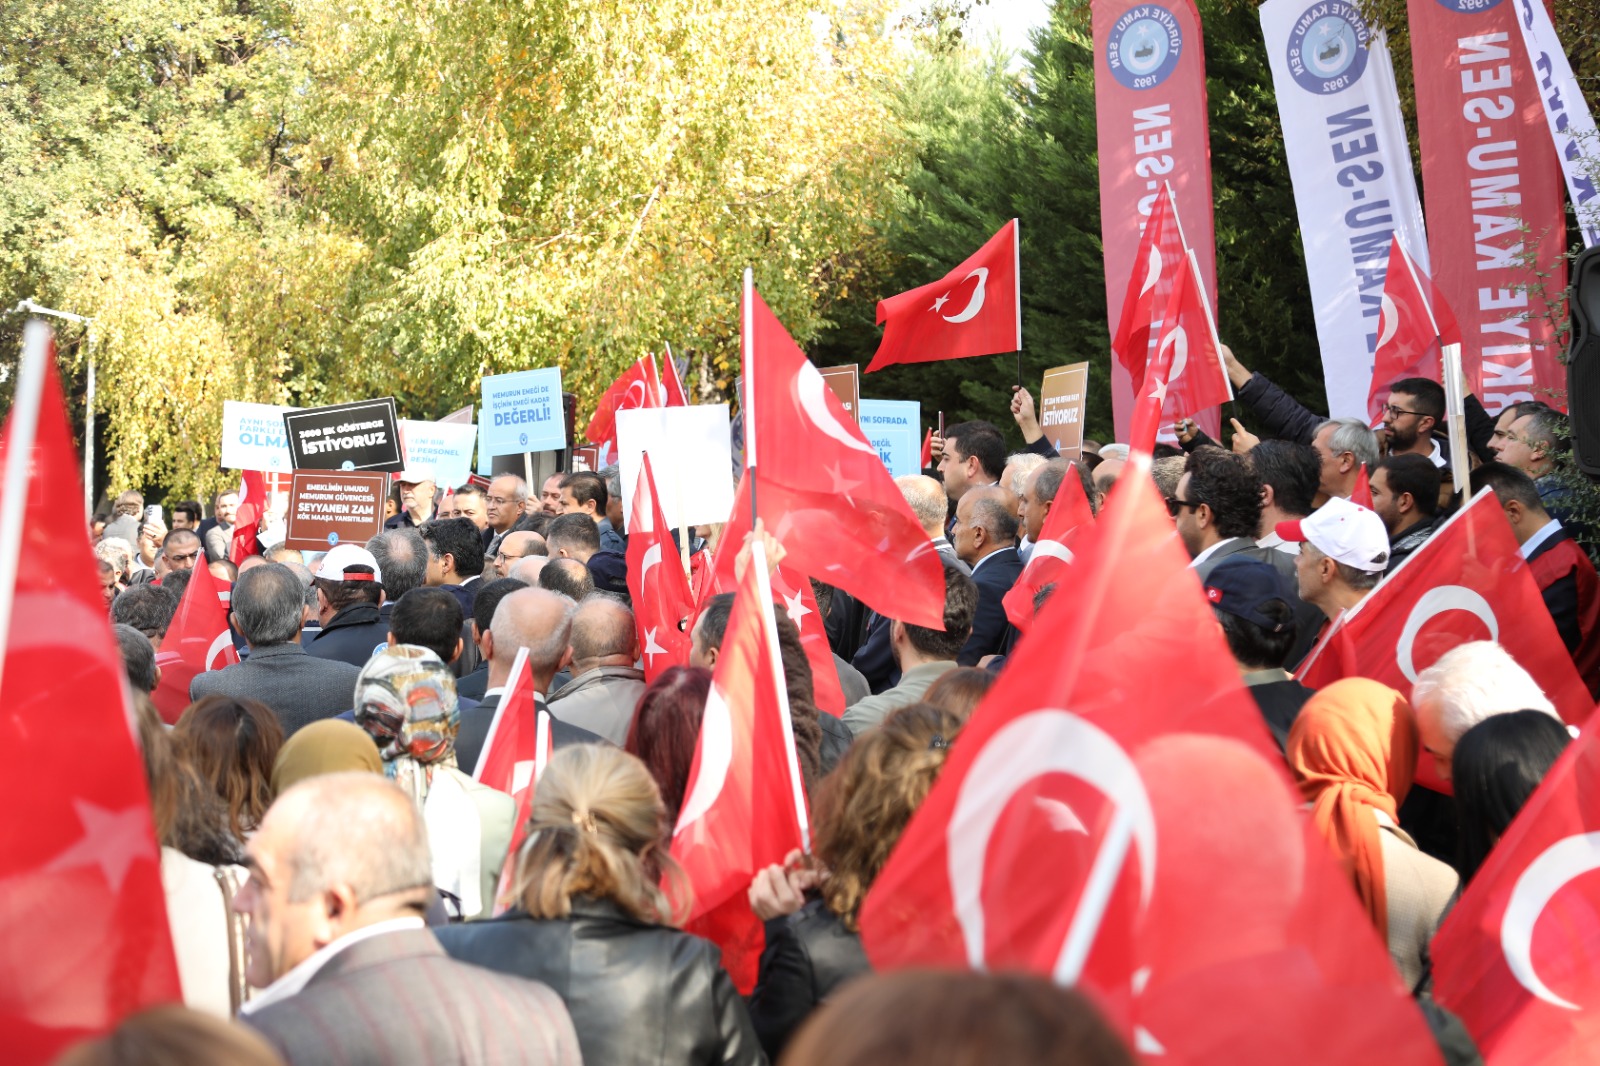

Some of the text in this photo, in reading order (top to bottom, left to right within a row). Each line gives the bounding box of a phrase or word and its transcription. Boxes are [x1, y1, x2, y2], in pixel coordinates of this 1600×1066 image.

[492, 390, 520, 399] MEMURUN
[522, 385, 539, 395] EMEĞİ
[531, 396, 550, 404] KADAR
[494, 403, 551, 426] DEĞERLİ!
[1043, 405, 1078, 426] İSTİYORUZ
[240, 418, 263, 426] AYNI
[859, 415, 908, 425] YNI SOFRADA
[240, 425, 277, 434] FARKLI
[322, 426, 336, 435] EK
[336, 419, 385, 433] GÖSTERGE
[301, 432, 387, 455] İSTİYORUZ
[872, 438, 891, 447] DEĞİL
[418, 447, 459, 456] PERSONEL
[410, 455, 438, 464] REJİMİ
[306, 482, 369, 492] EMEKLİNİN UMUDU
[299, 492, 334, 500] MEMURUN
[298, 502, 374, 514] SEYYANEN ZAM
[311, 514, 334, 522] MAAŞA
